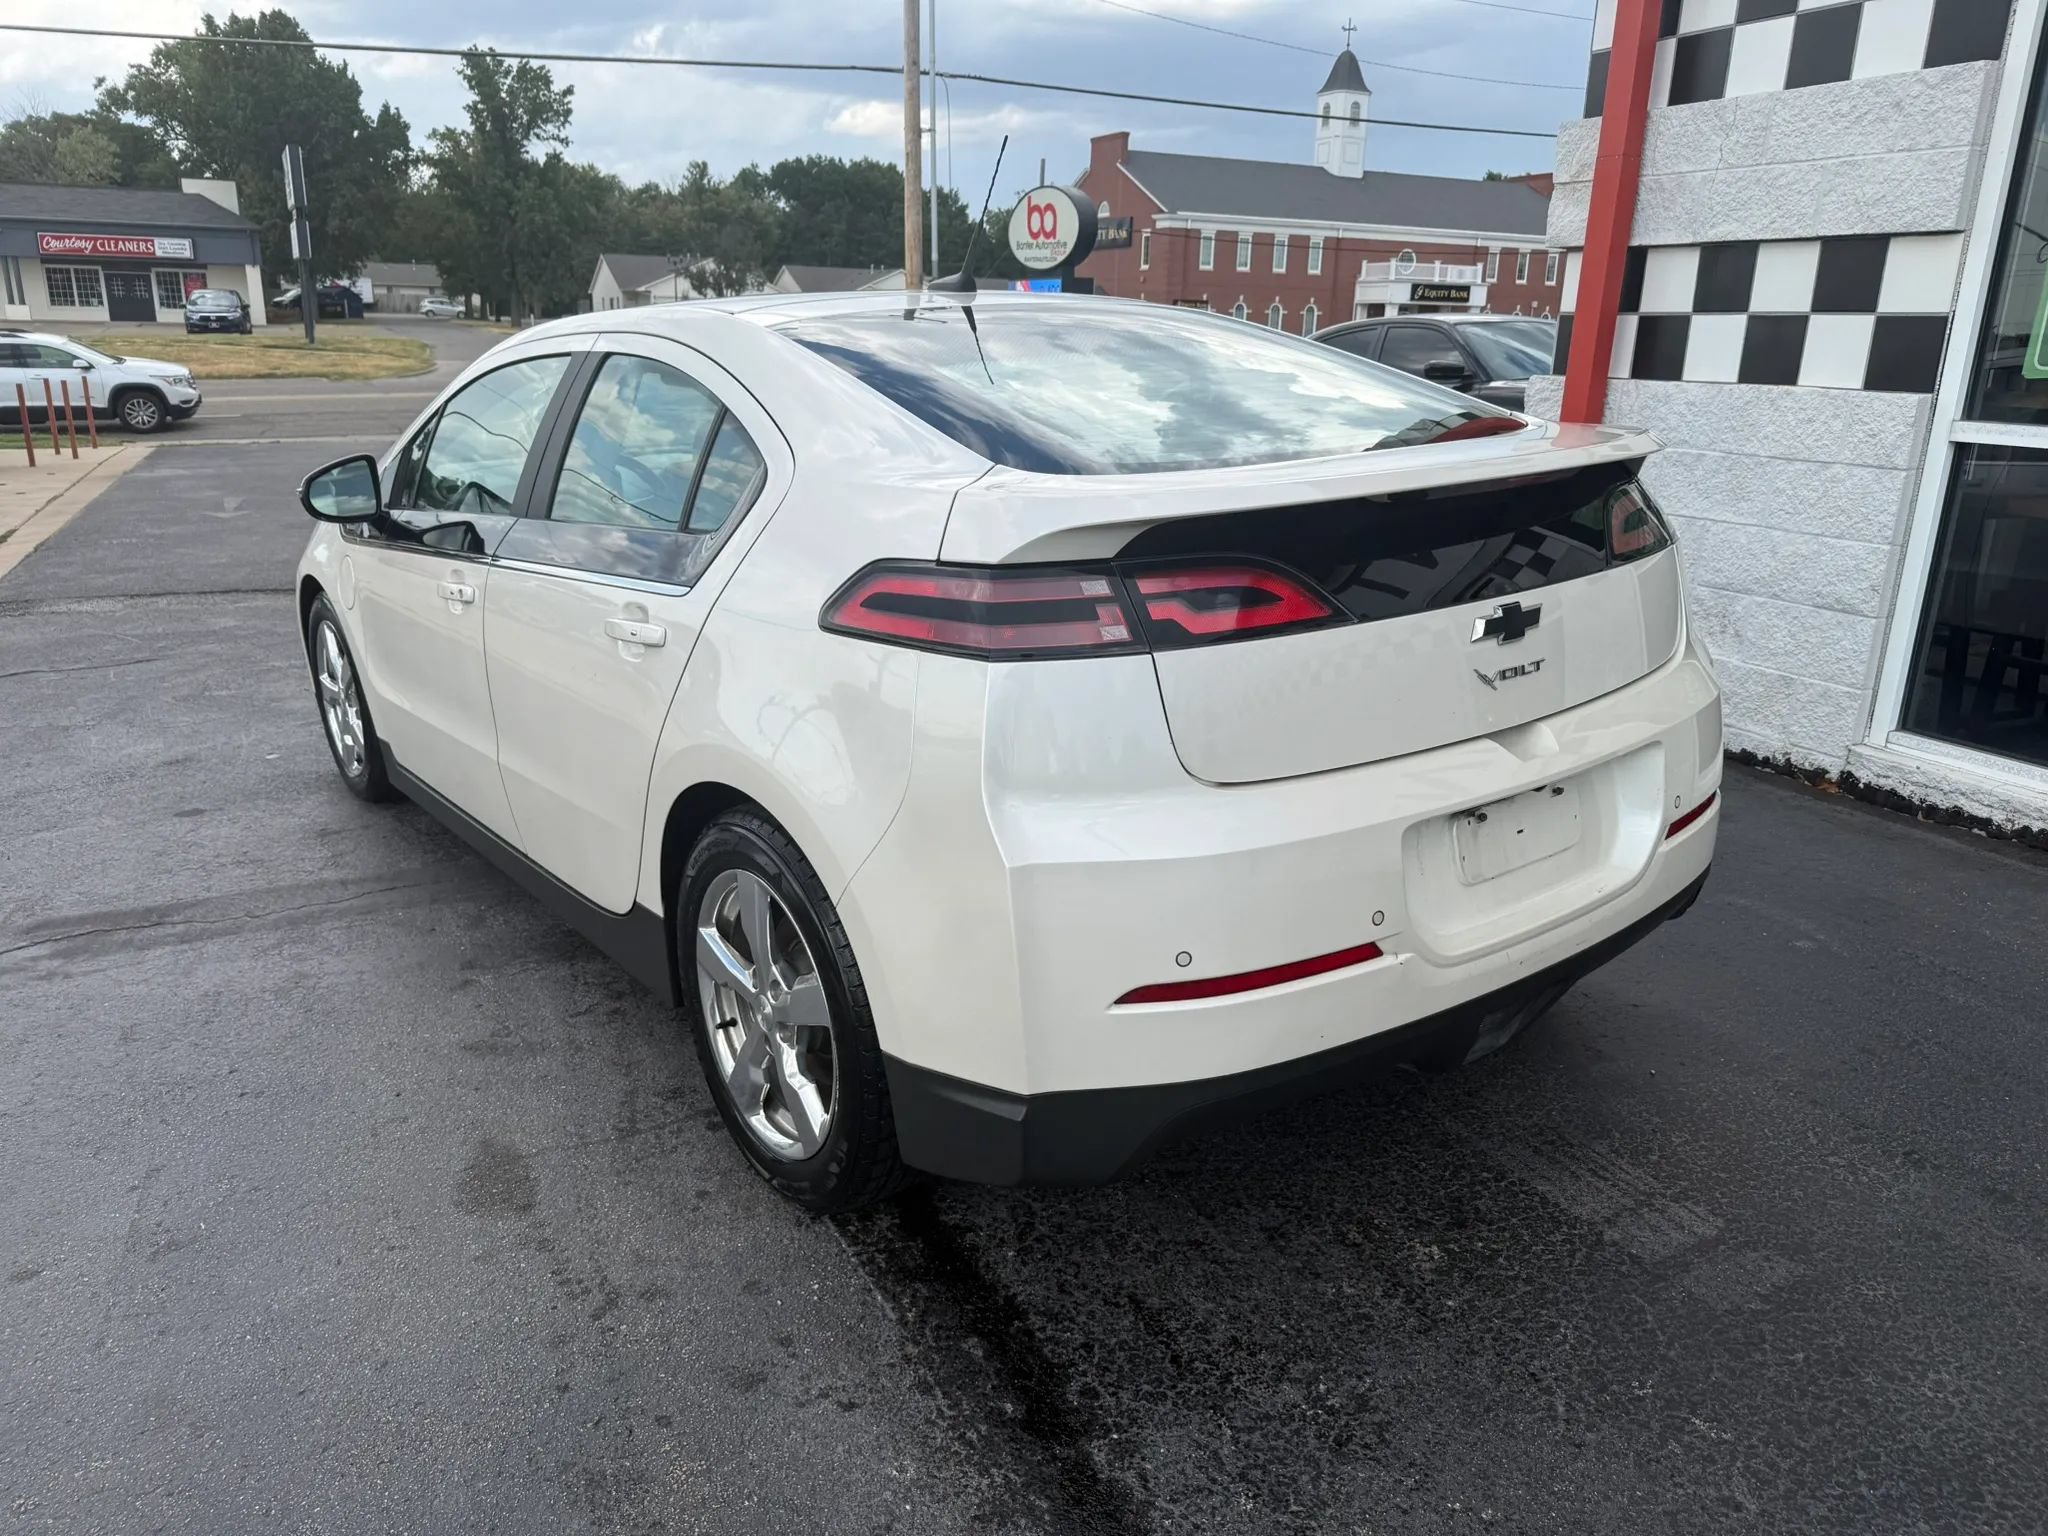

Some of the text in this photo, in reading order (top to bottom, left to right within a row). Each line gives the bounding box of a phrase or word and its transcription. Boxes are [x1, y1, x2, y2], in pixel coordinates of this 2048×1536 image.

[43, 236, 154, 254] Courtesy CLEANERS
[1424, 288, 1468, 298] EQUITY BANK
[1473, 658, 1546, 691] VOLT
